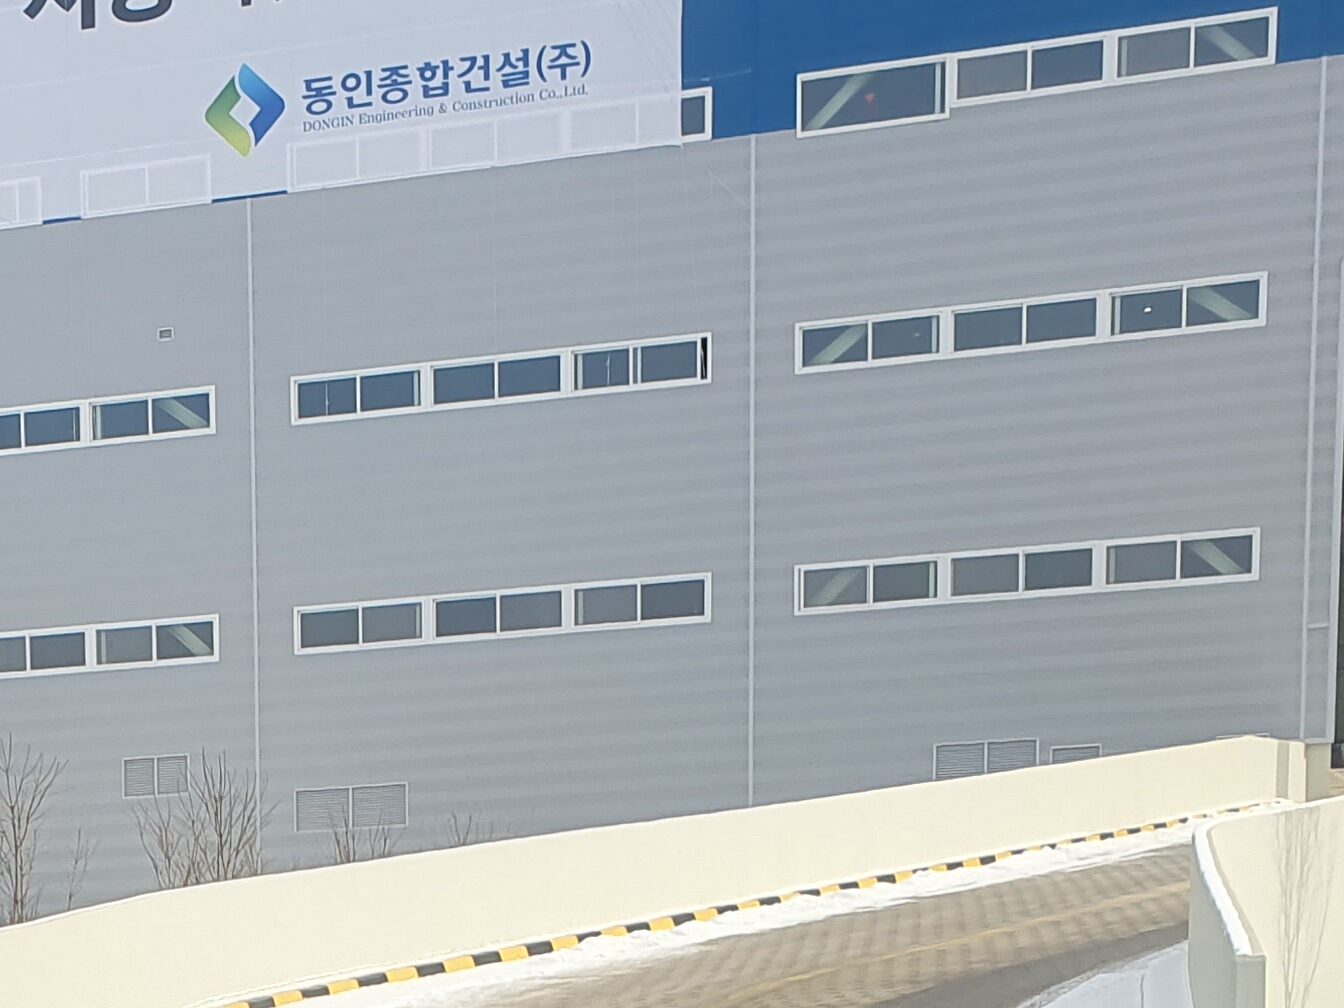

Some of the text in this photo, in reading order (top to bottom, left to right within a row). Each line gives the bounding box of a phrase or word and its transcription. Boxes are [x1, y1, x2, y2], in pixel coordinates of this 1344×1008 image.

[301, 40, 592, 116] 동인종합건설(주)
[302, 114, 355, 133] DONGIN
[358, 104, 435, 125] Engineering
[438, 102, 449, 114] &
[452, 91, 535, 112] Construction
